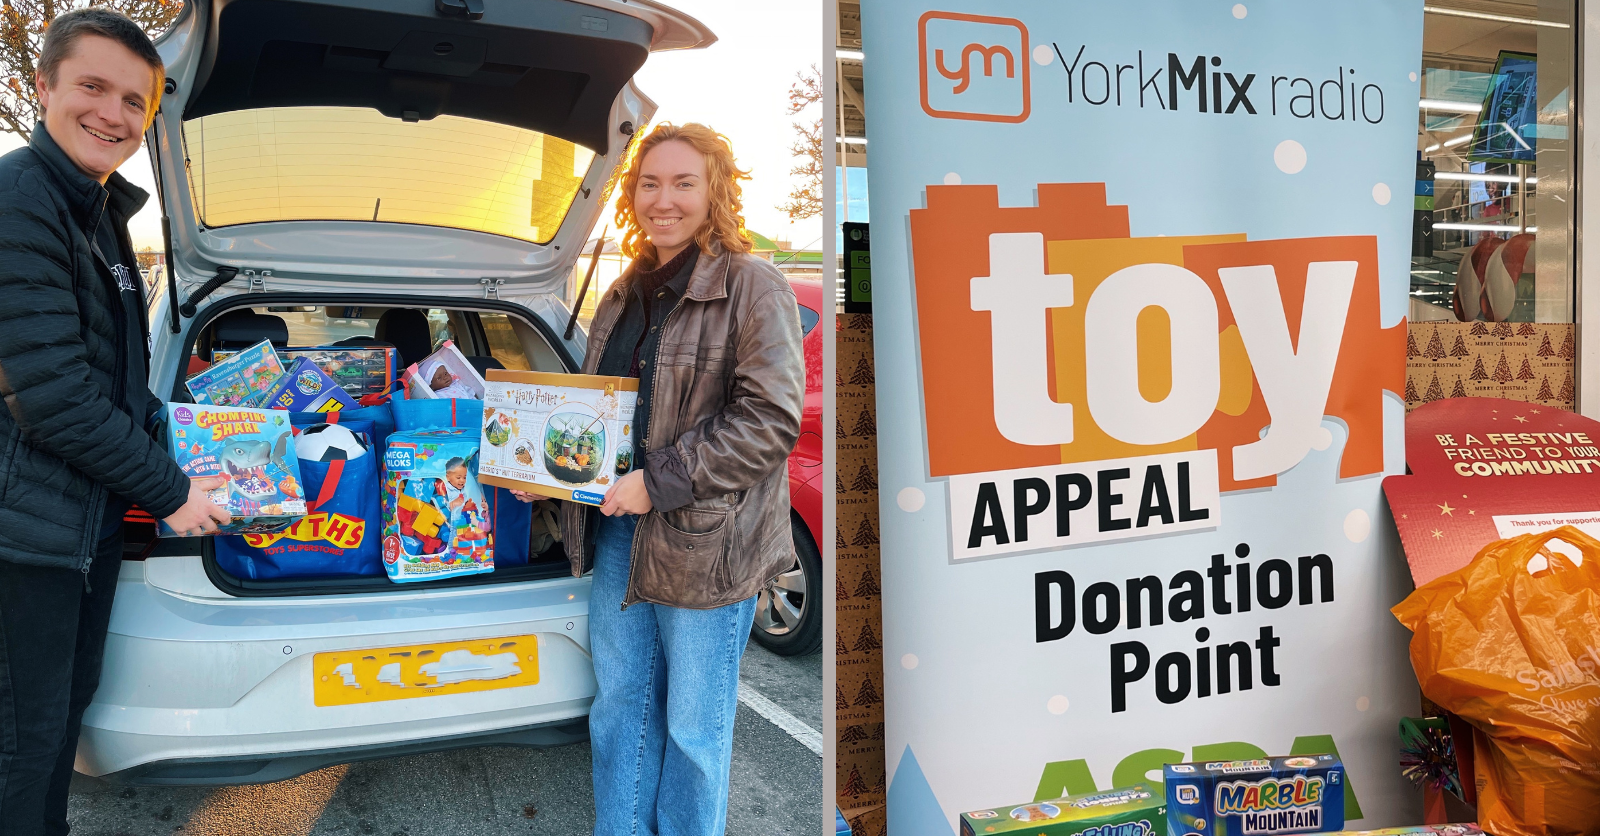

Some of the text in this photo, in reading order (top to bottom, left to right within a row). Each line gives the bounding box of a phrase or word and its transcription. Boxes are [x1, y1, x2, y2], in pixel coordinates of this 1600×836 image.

[1052, 42, 1385, 125] YorkMix radio
[970, 232, 1359, 481] toy
[211, 358, 245, 379] Ravensburger
[244, 352, 260, 363] Puzzle
[279, 393, 294, 407] 50
[514, 388, 558, 408] Harry Potter
[195, 411, 267, 428] CHOMPING
[211, 423, 261, 441] SHARK
[1435, 432, 1593, 446] BE A FESTIVE
[386, 451, 410, 459] MEGA
[1444, 446, 1600, 460] FRIEND TO YOUR
[387, 459, 411, 467] BLOKS
[502, 469, 511, 477] HUT
[511, 472, 536, 482] TERRARIUM
[967, 461, 1210, 549] APPEAL
[249, 517, 363, 546] SYTHS
[1536, 519, 1551, 527] you
[263, 545, 345, 556] TOYS SUPERSTORES
[1034, 542, 1335, 644] Donation
[1110, 625, 1281, 714] Point
[849, 746, 876, 755] MERRY
[1208, 760, 1269, 770] MARBLE
[850, 800, 878, 808] MERRY
[1218, 779, 1320, 812] MARBLE
[1245, 809, 1319, 831] MOUNTAIN
